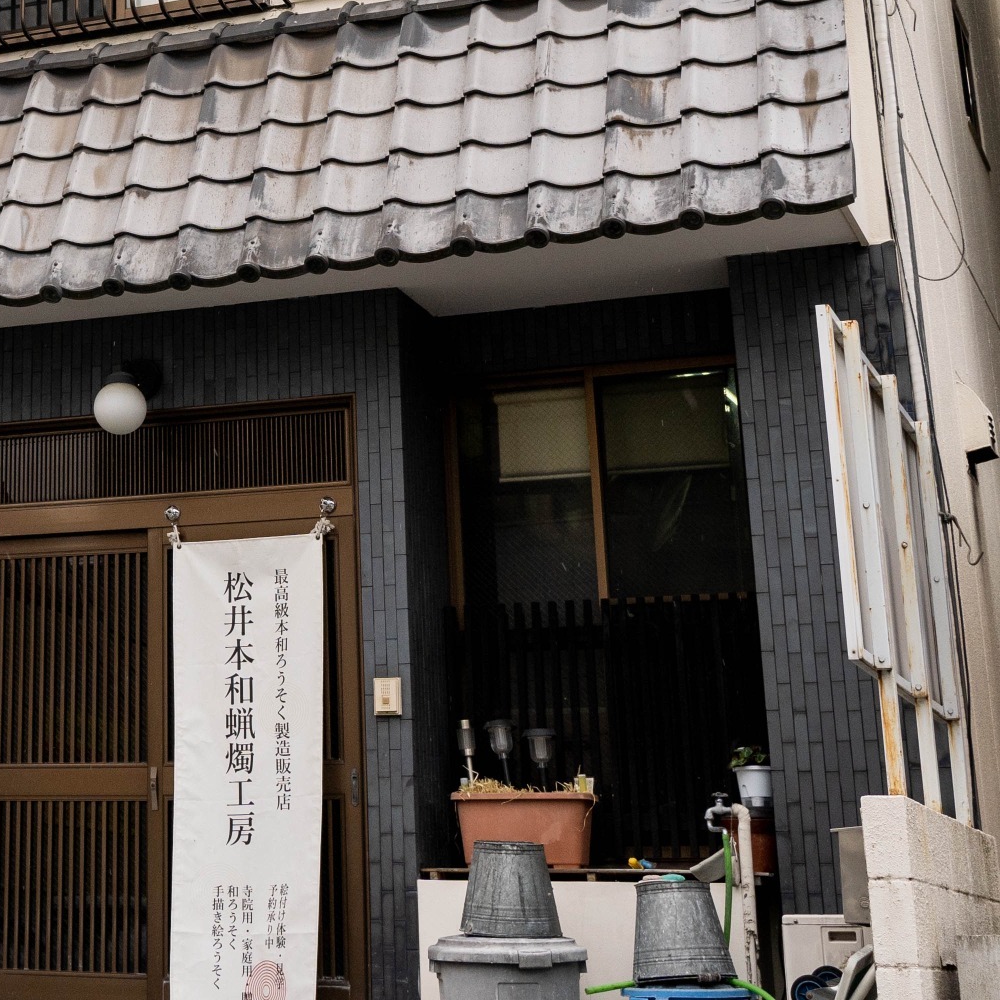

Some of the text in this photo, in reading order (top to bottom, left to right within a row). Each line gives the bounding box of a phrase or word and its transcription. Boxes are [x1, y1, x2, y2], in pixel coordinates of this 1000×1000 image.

[223, 571, 256, 846] 松井本和蝋燭工房
[274, 568, 291, 811] 最高級本和ろうそく製造販売店
[211, 884, 224, 990] 手描き絵ろうそく
[227, 884, 239, 950] 和ろうそく
[264, 884, 278, 950] 予約承り中
[275, 883, 289, 990] 絵付け体験・見学
